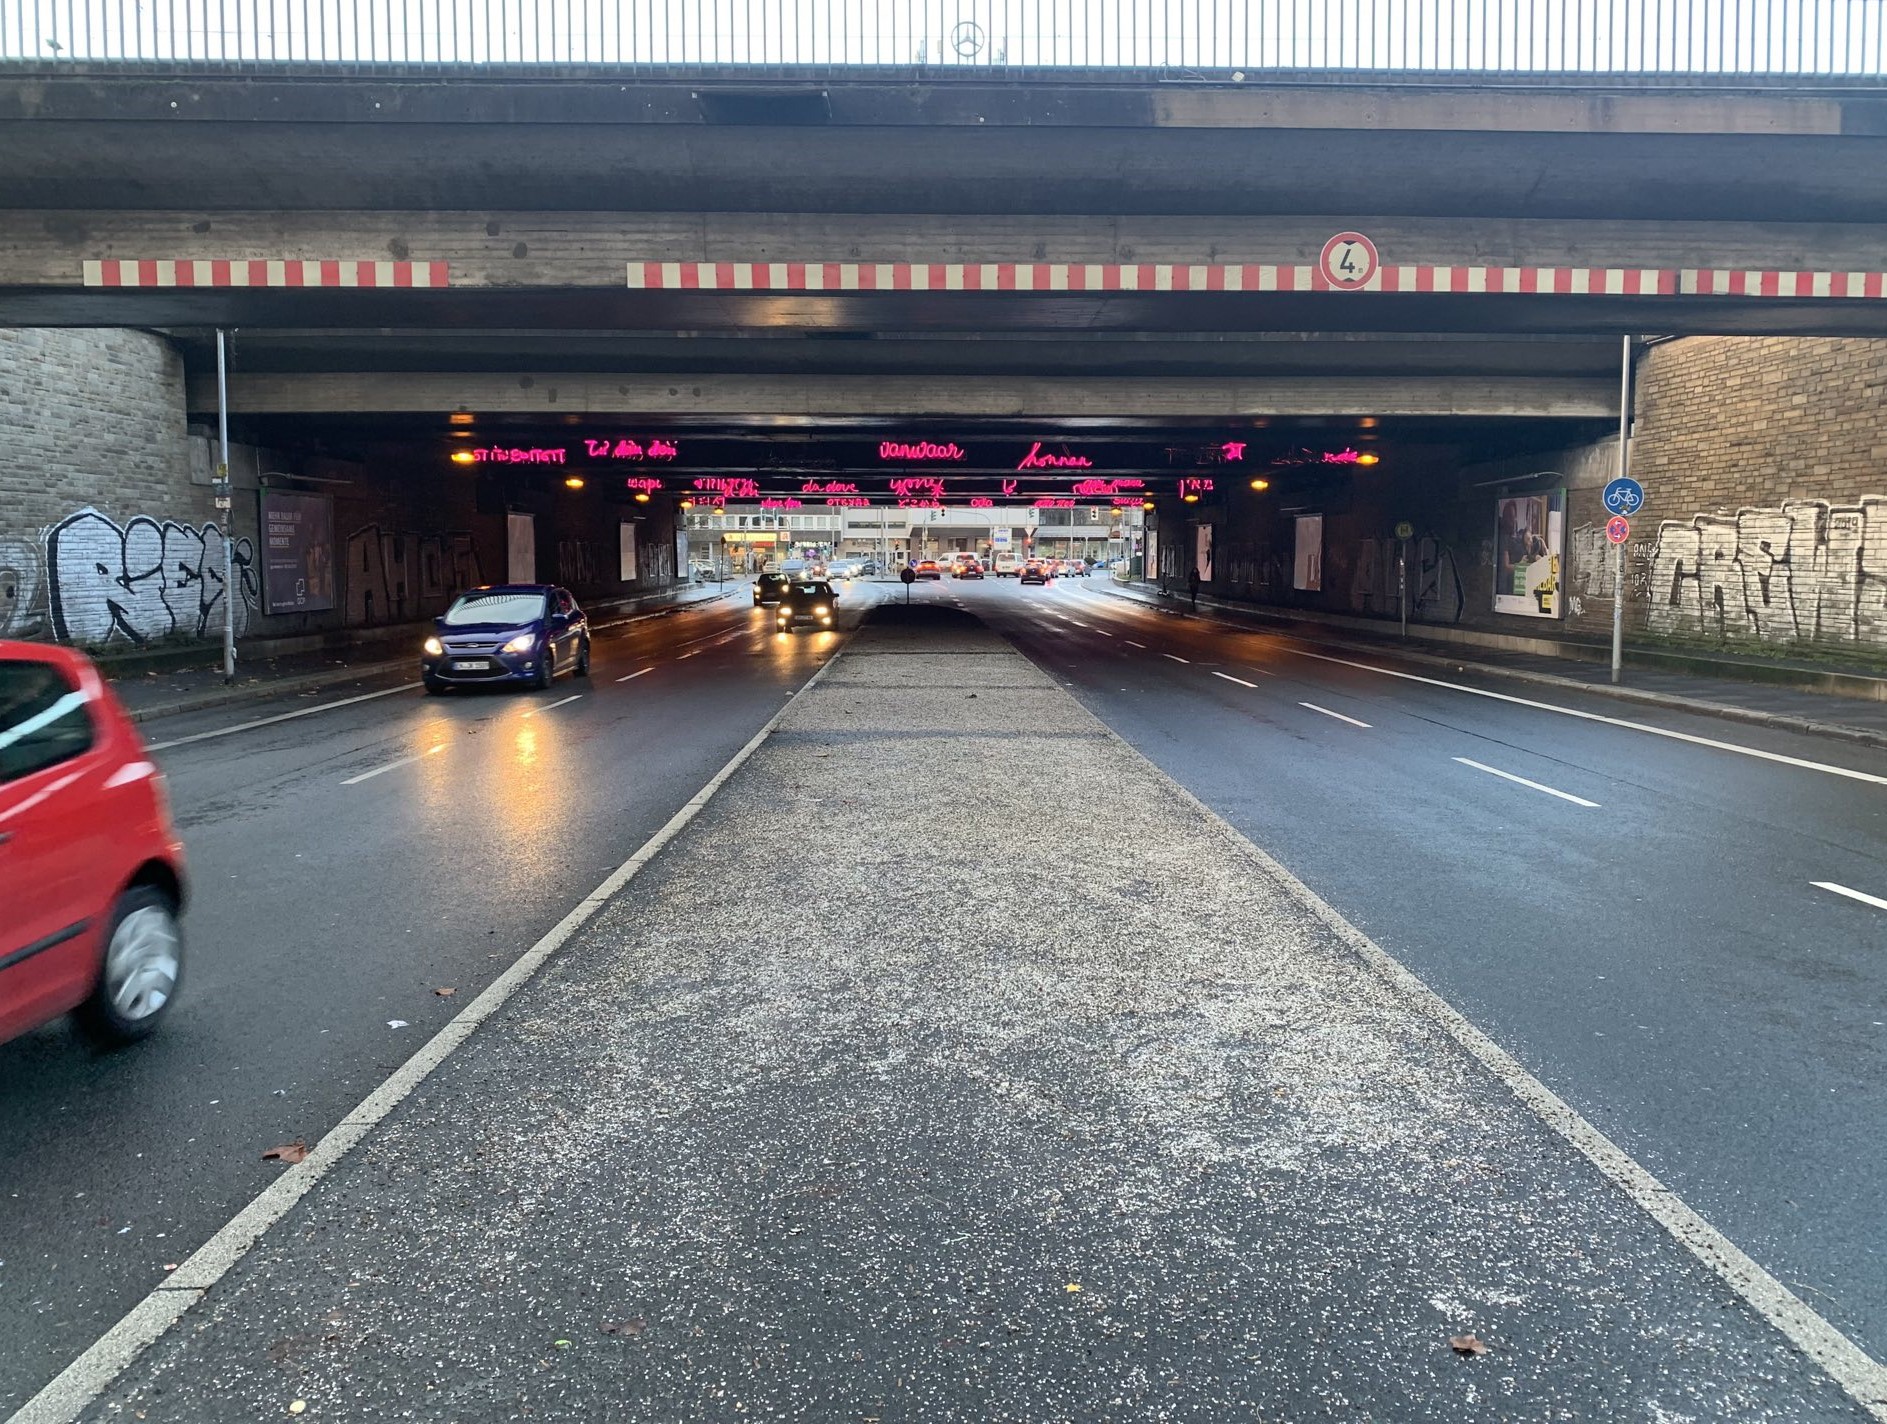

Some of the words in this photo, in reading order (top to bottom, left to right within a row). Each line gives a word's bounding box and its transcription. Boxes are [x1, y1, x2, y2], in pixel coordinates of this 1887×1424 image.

[1340, 248, 1356, 274] 4
[879, 441, 964, 459] vanwaar
[1018, 442, 1093, 470] honnan
[802, 479, 824, 493] da
[825, 480, 860, 493] dove
